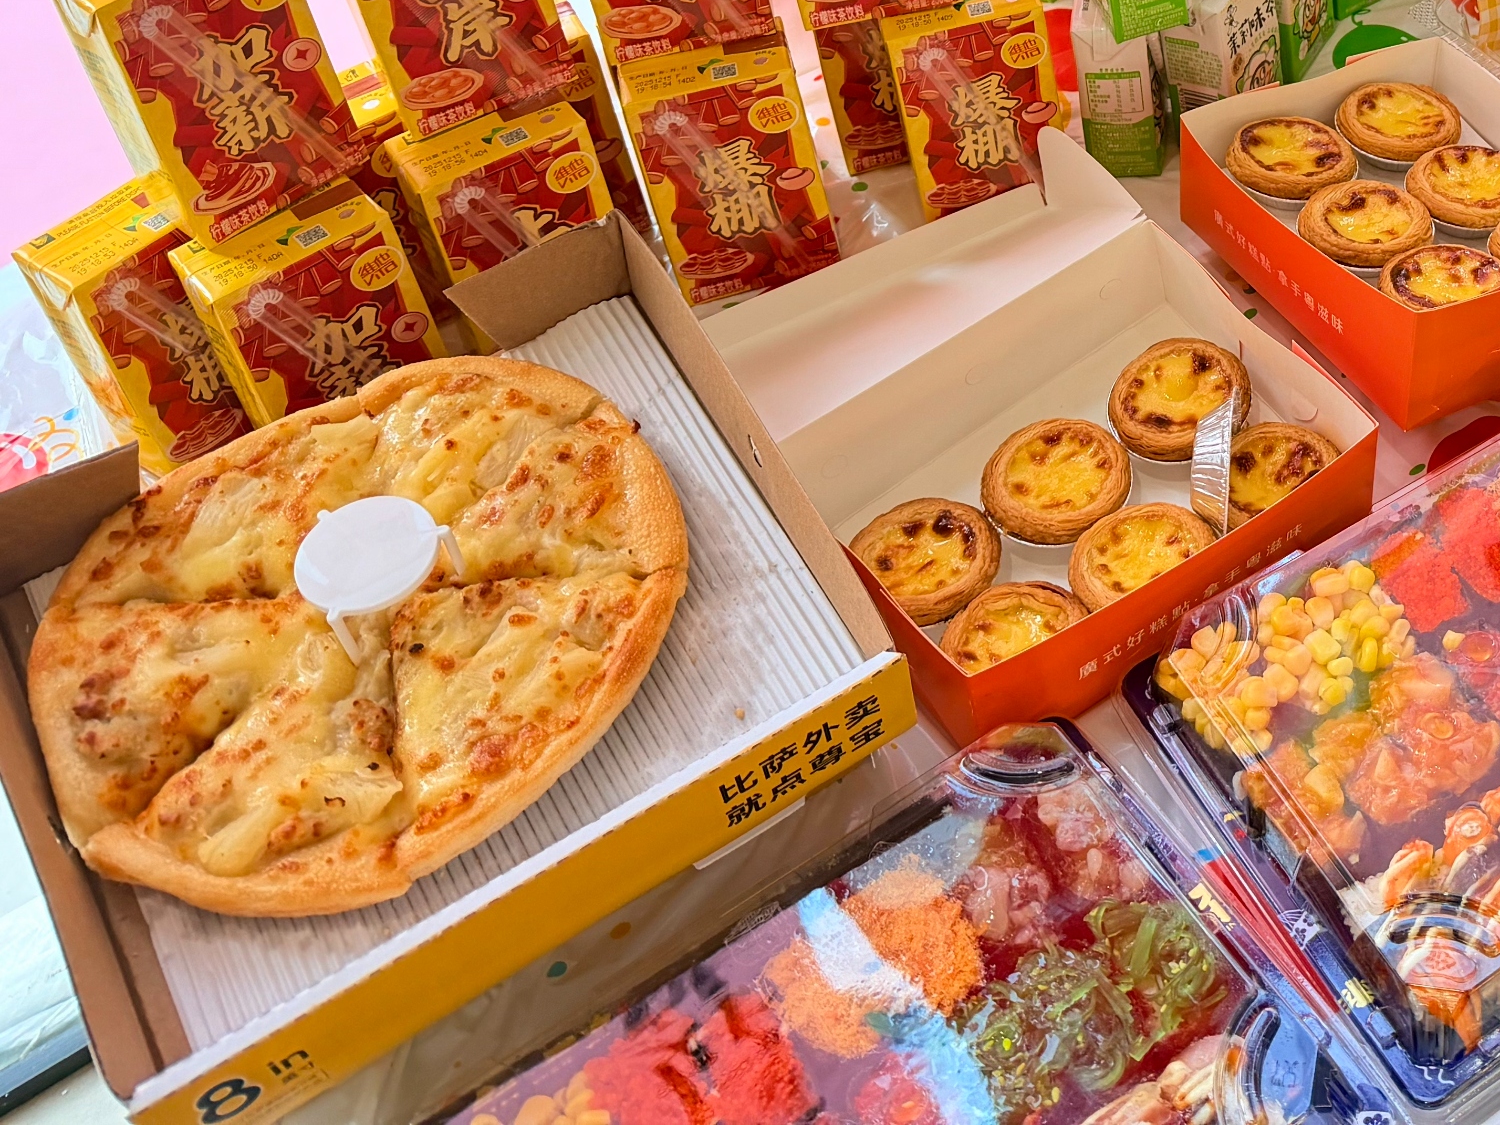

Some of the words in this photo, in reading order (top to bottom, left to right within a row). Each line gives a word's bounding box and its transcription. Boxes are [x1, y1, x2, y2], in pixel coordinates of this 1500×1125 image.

[718, 693, 882, 804] 比萨外卖
[725, 718, 888, 828] 就点尊宝
[196, 1078, 262, 1124] 8
